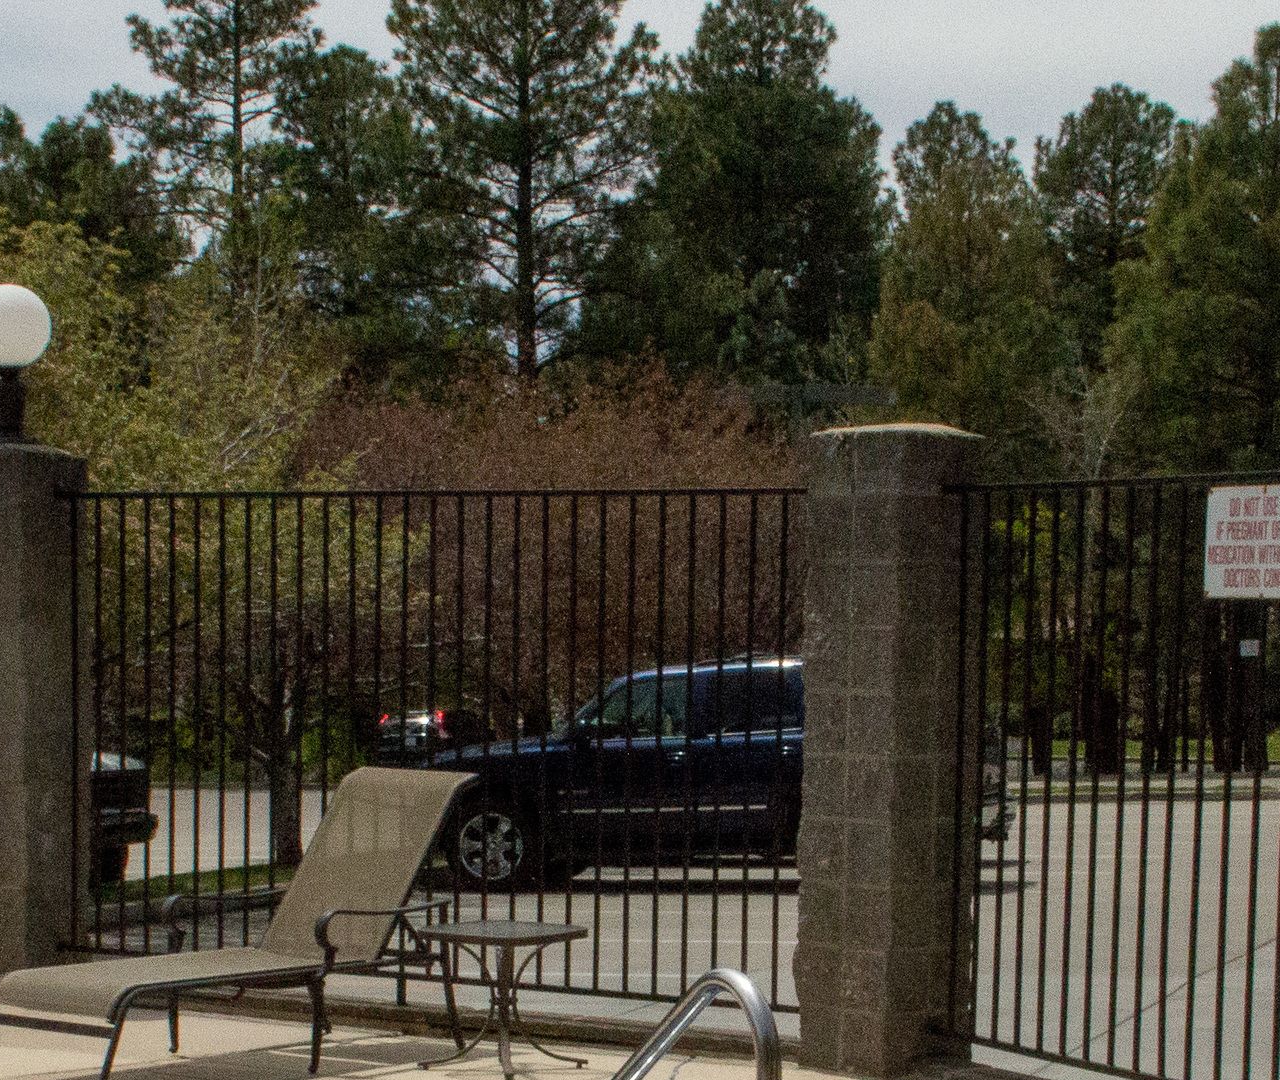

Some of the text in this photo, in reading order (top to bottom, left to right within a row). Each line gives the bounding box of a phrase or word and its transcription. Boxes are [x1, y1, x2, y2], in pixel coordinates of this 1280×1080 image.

[1229, 497, 1240, 517] DO
[1244, 496, 1261, 516] NOT
[1263, 495, 1278, 516] USE
[1216, 521, 1225, 540] IF
[1226, 520, 1269, 540] PREGNANT
[1208, 545, 1255, 565] MEDICATION
[1223, 568, 1261, 588] DOCTORS
